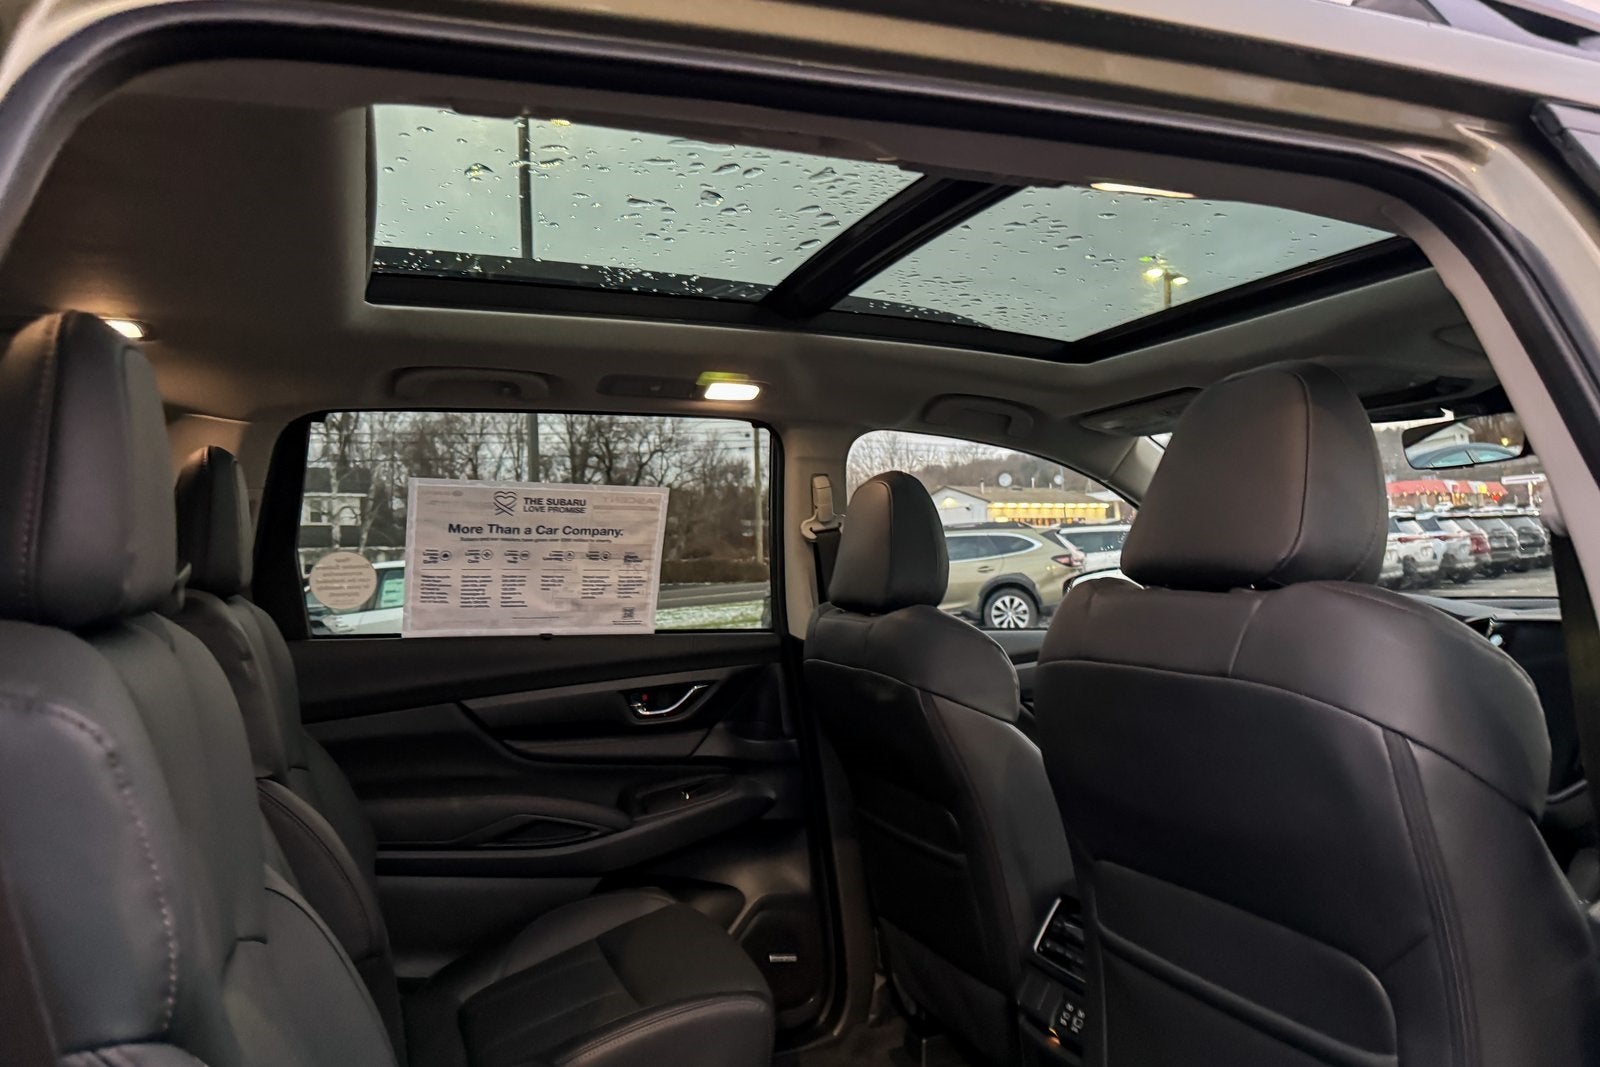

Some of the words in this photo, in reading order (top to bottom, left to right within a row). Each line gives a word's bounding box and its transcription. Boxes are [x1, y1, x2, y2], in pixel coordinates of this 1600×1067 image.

[523, 497, 544, 506] THE
[546, 498, 587, 507] SUBARU
[523, 505, 546, 513] LOVE
[547, 506, 587, 514] PROMISE
[448, 523, 483, 534] More
[487, 524, 520, 535] Than
[523, 527, 532, 535] a
[535, 525, 560, 535] Car
[562, 525, 624, 538] Company.
